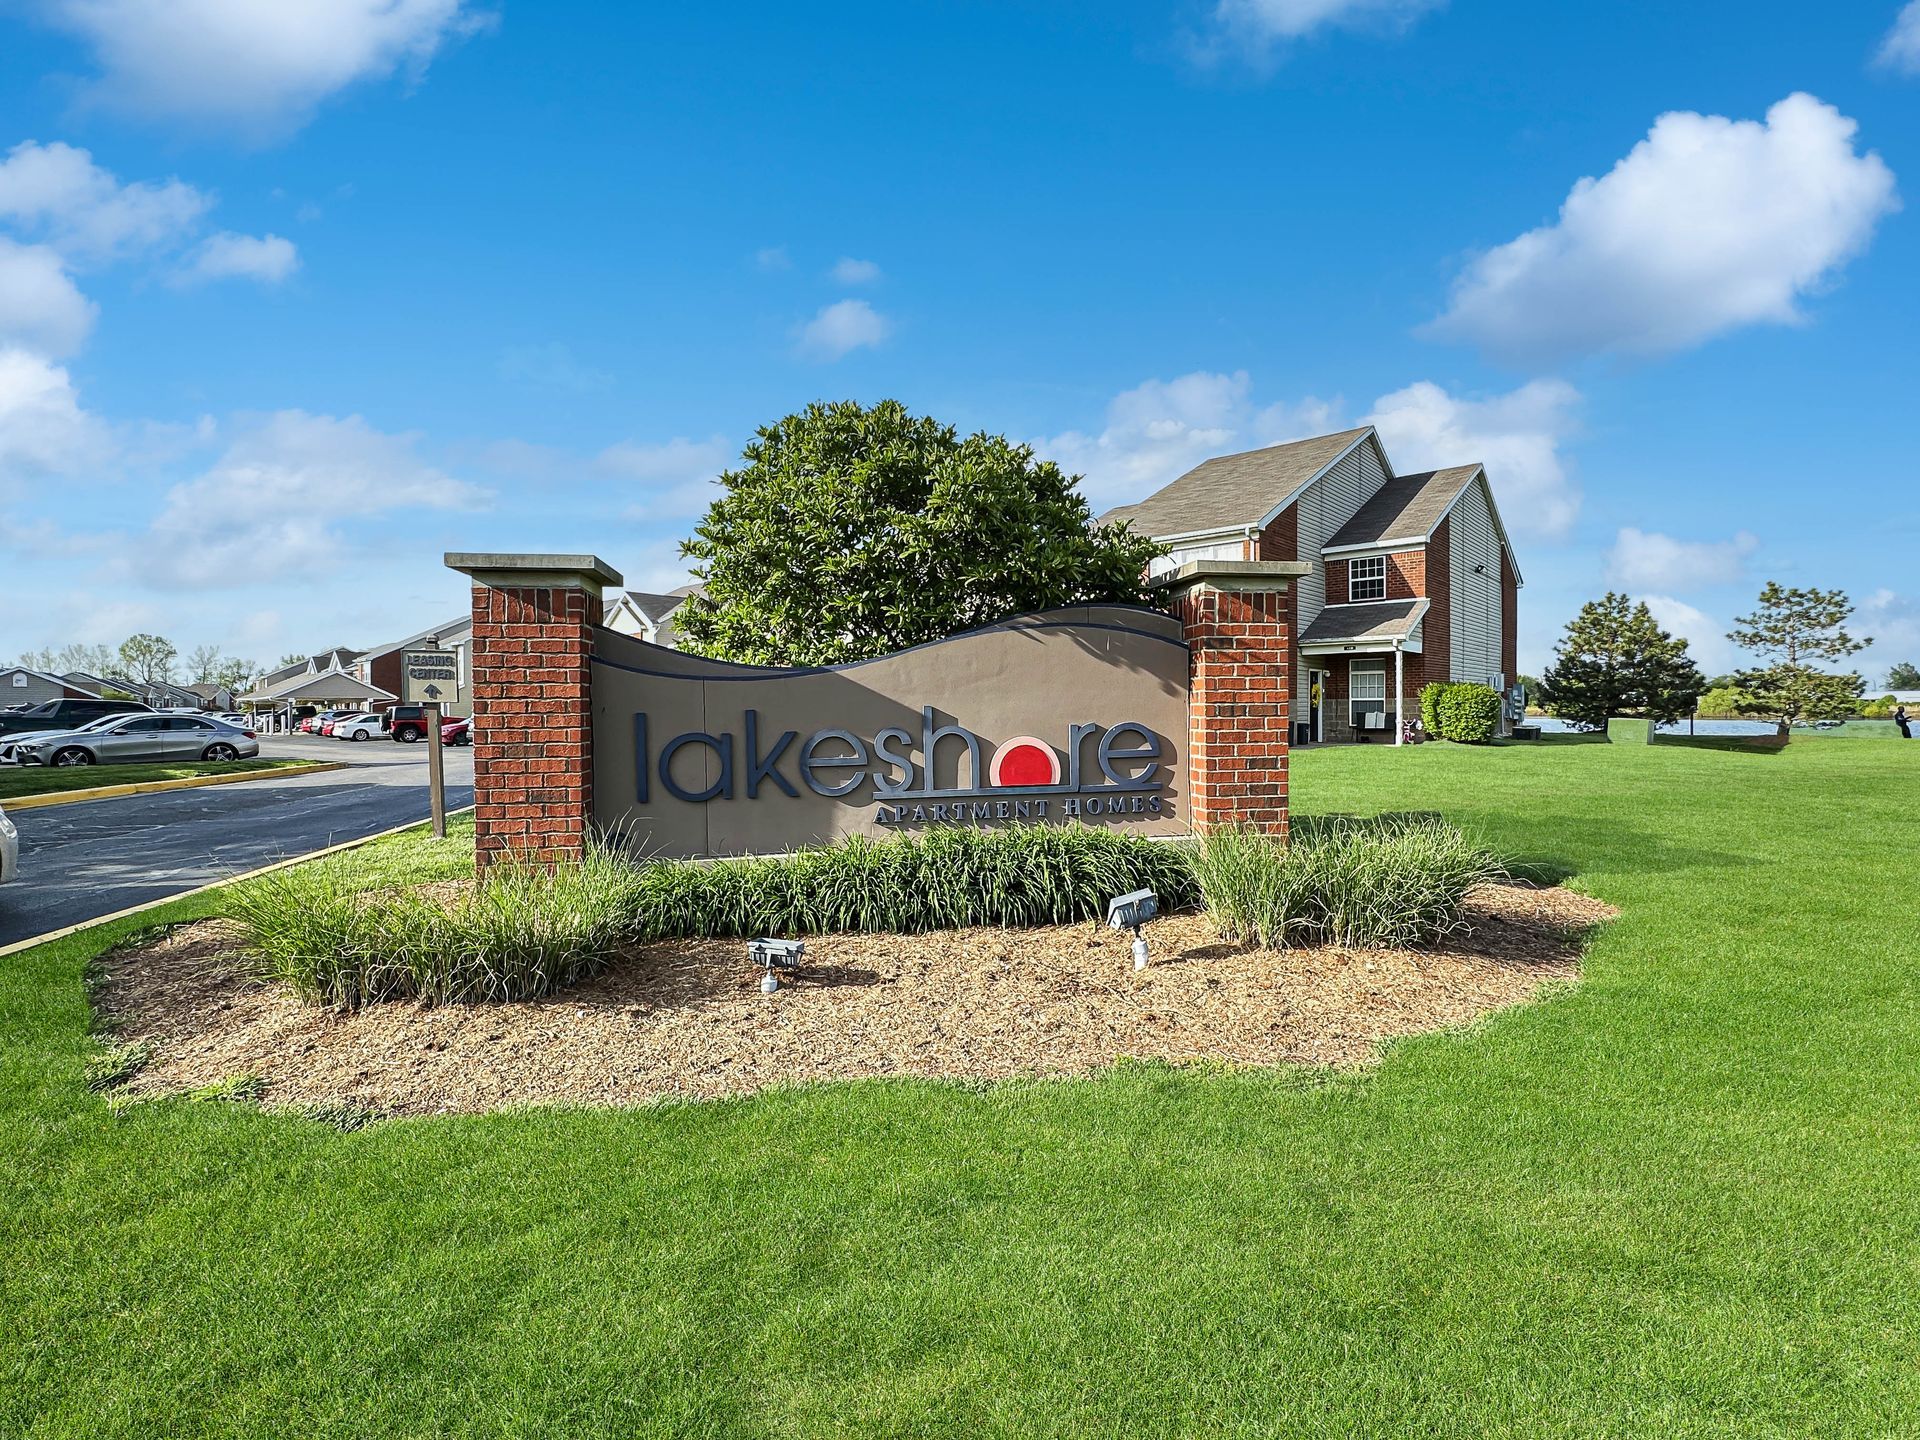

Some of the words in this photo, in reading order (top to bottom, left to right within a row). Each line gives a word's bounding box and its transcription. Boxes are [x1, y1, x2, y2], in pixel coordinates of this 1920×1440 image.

[407, 654, 454, 667] LEASING
[409, 668, 455, 680] CENTER
[635, 705, 1162, 804] lakeshore
[872, 799, 1050, 823] APARTMENT
[1064, 795, 1162, 816] HOMES
